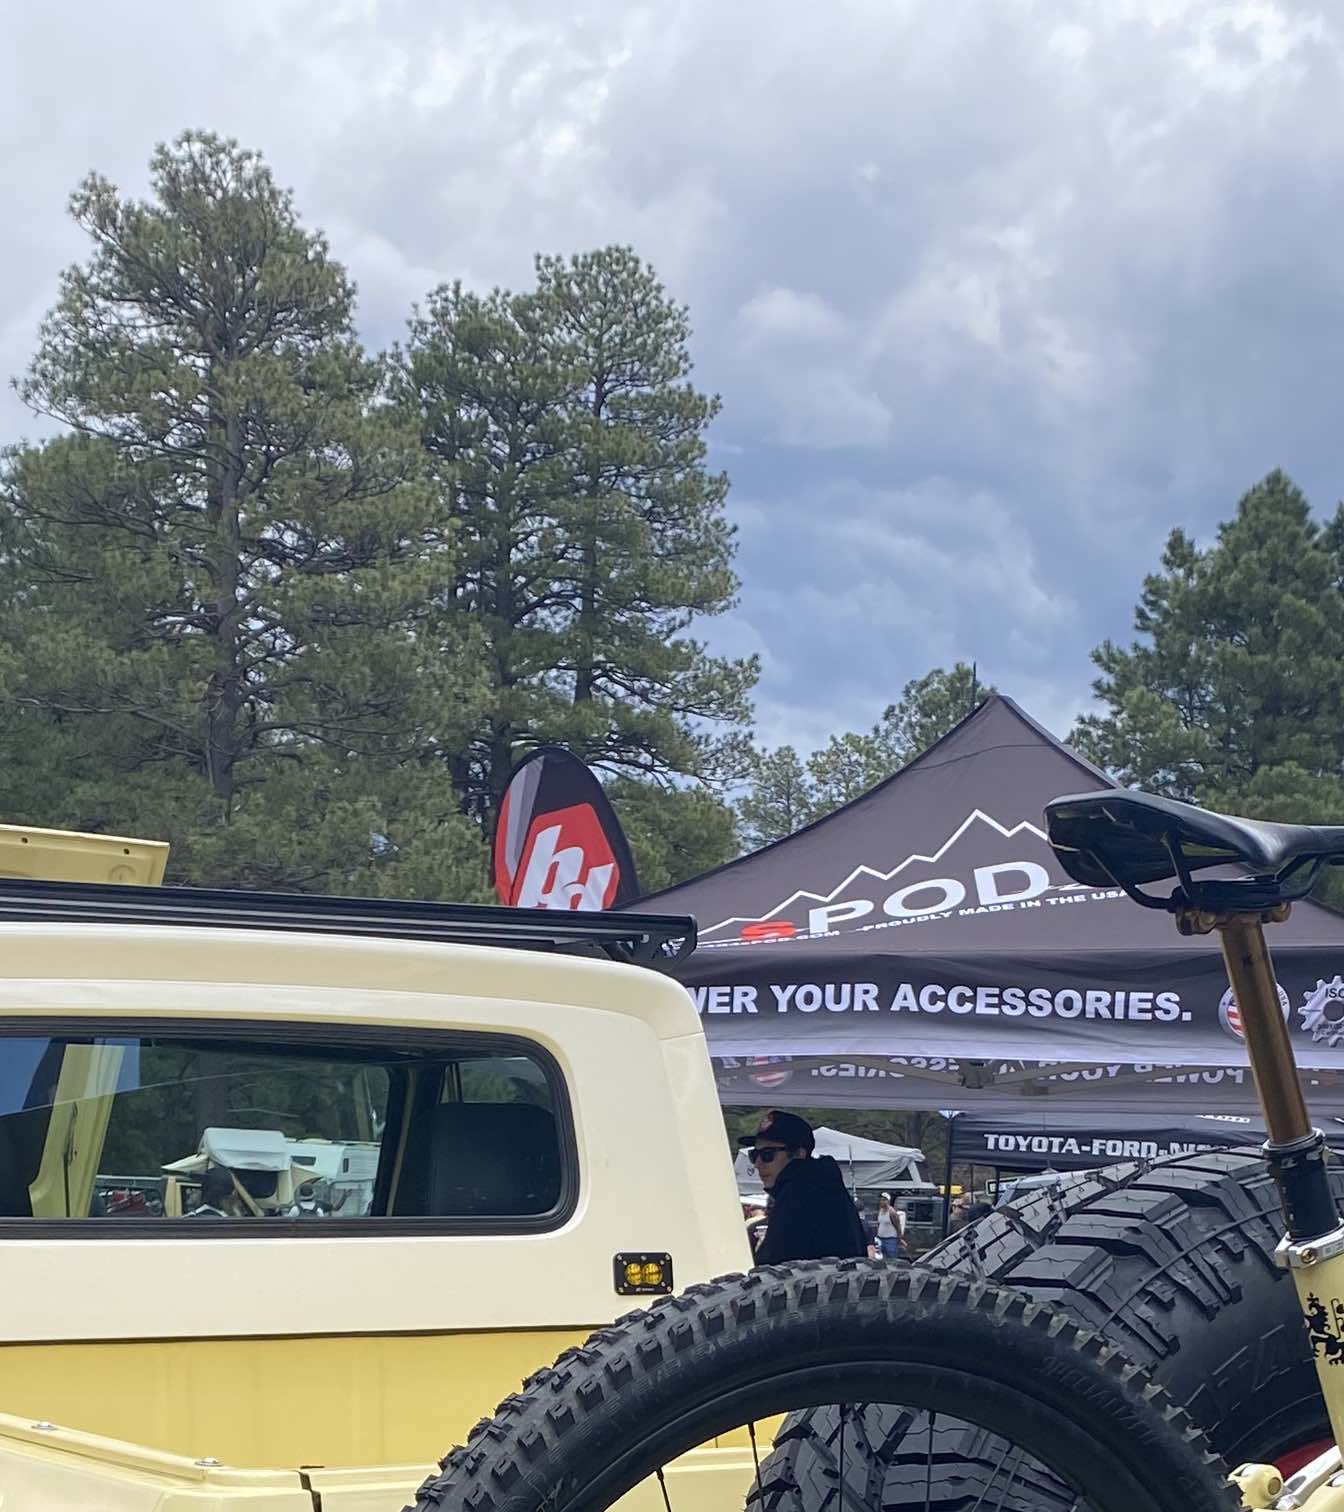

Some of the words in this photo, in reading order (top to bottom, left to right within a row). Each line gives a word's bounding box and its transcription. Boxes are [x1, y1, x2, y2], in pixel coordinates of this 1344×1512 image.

[861, 911, 952, 932] PROUDLY
[958, 903, 1015, 916] MADE
[1020, 900, 1041, 909] IN
[1045, 893, 1087, 906] THE
[688, 986, 758, 1014] WER
[770, 984, 879, 1013] YOUR
[891, 984, 1193, 1022] ACCESSORIES.
